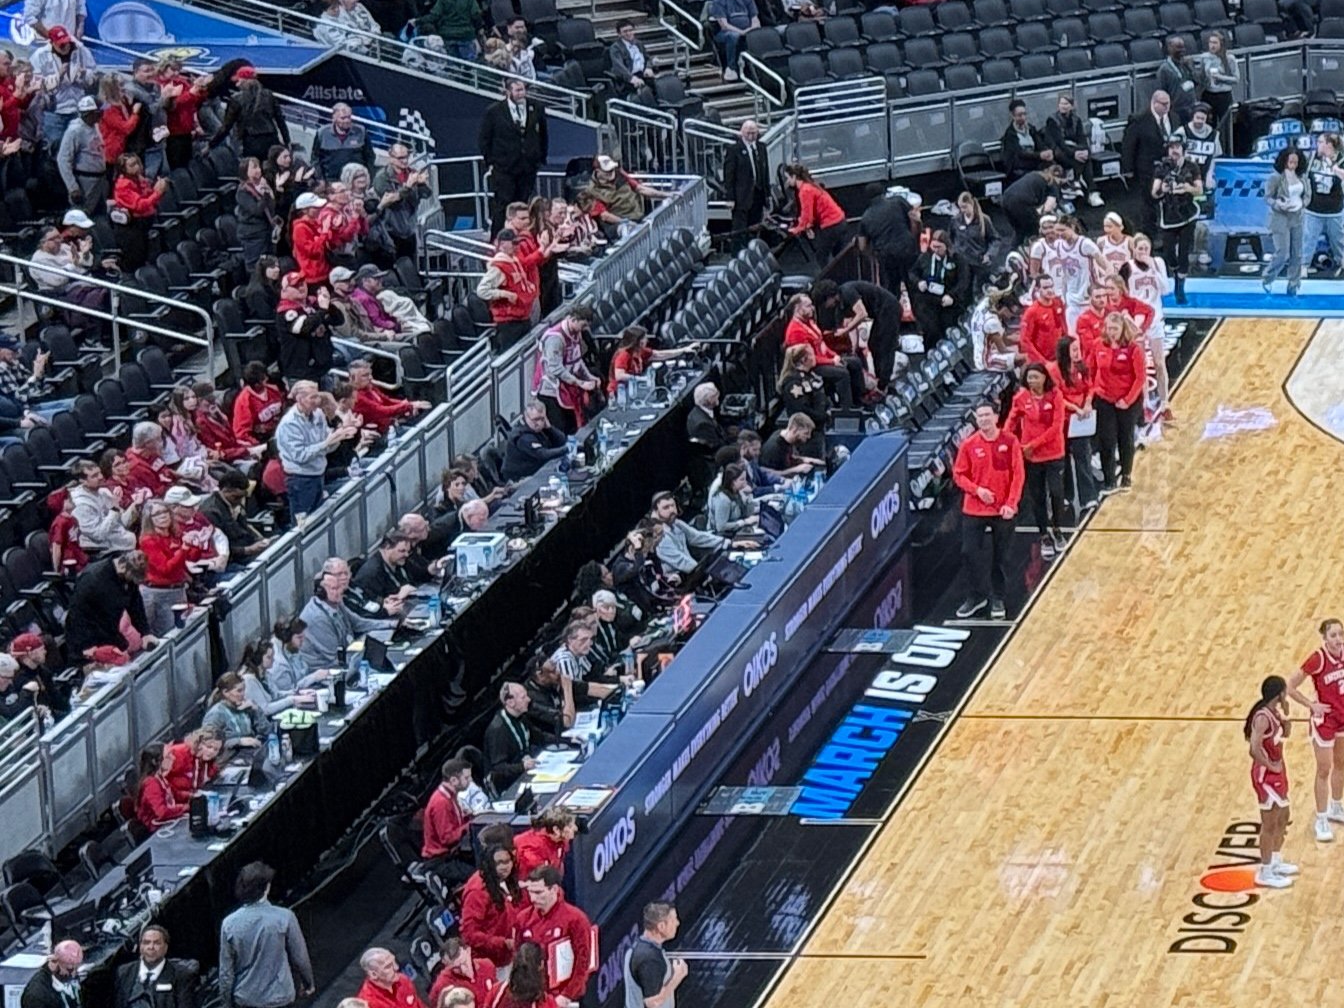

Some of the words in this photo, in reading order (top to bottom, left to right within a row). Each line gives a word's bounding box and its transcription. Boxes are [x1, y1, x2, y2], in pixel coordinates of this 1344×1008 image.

[302, 84, 365, 101] Allstate
[870, 483, 900, 540] OIKOS
[743, 631, 778, 698] OIKOS
[891, 624, 971, 668] ON
[864, 670, 938, 704] IS
[789, 703, 914, 819] MARCH
[593, 806, 636, 882] OIKOS
